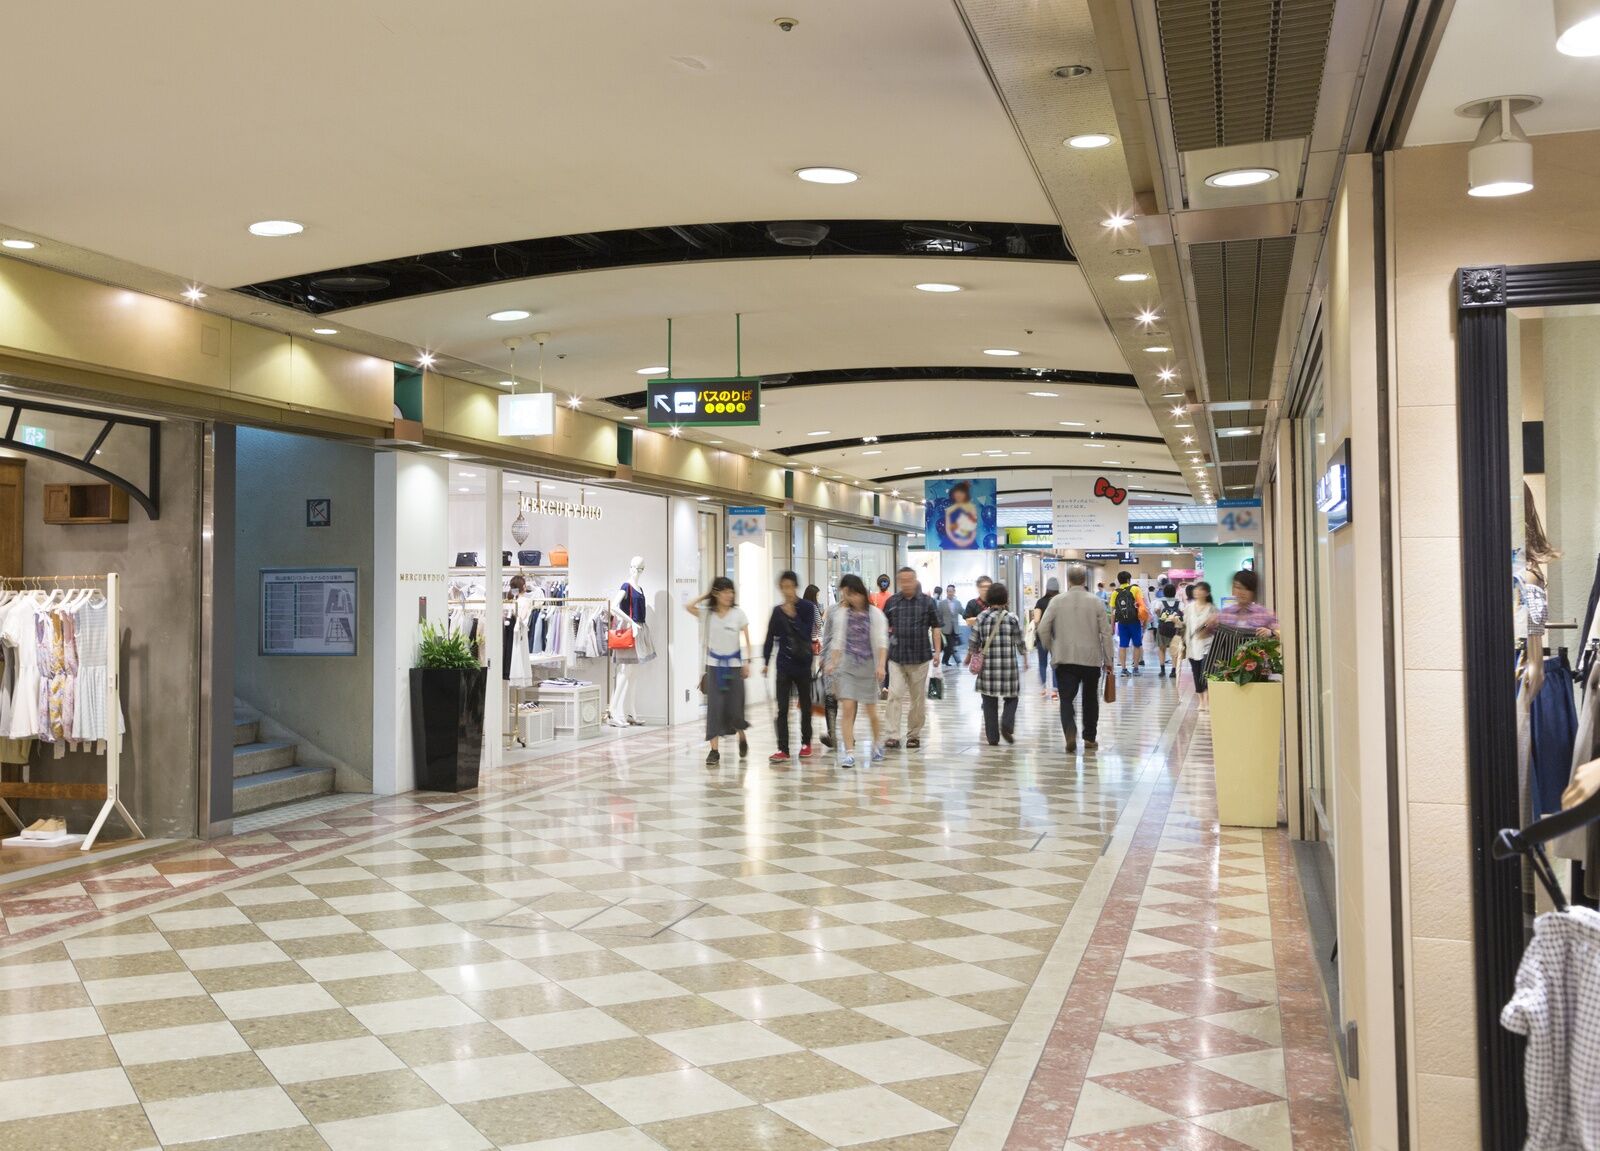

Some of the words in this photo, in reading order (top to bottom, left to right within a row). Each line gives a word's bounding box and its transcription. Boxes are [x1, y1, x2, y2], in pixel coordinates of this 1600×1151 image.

[697, 390, 753, 402] バスのりば
[520, 496, 603, 520] MERCURYDUO
